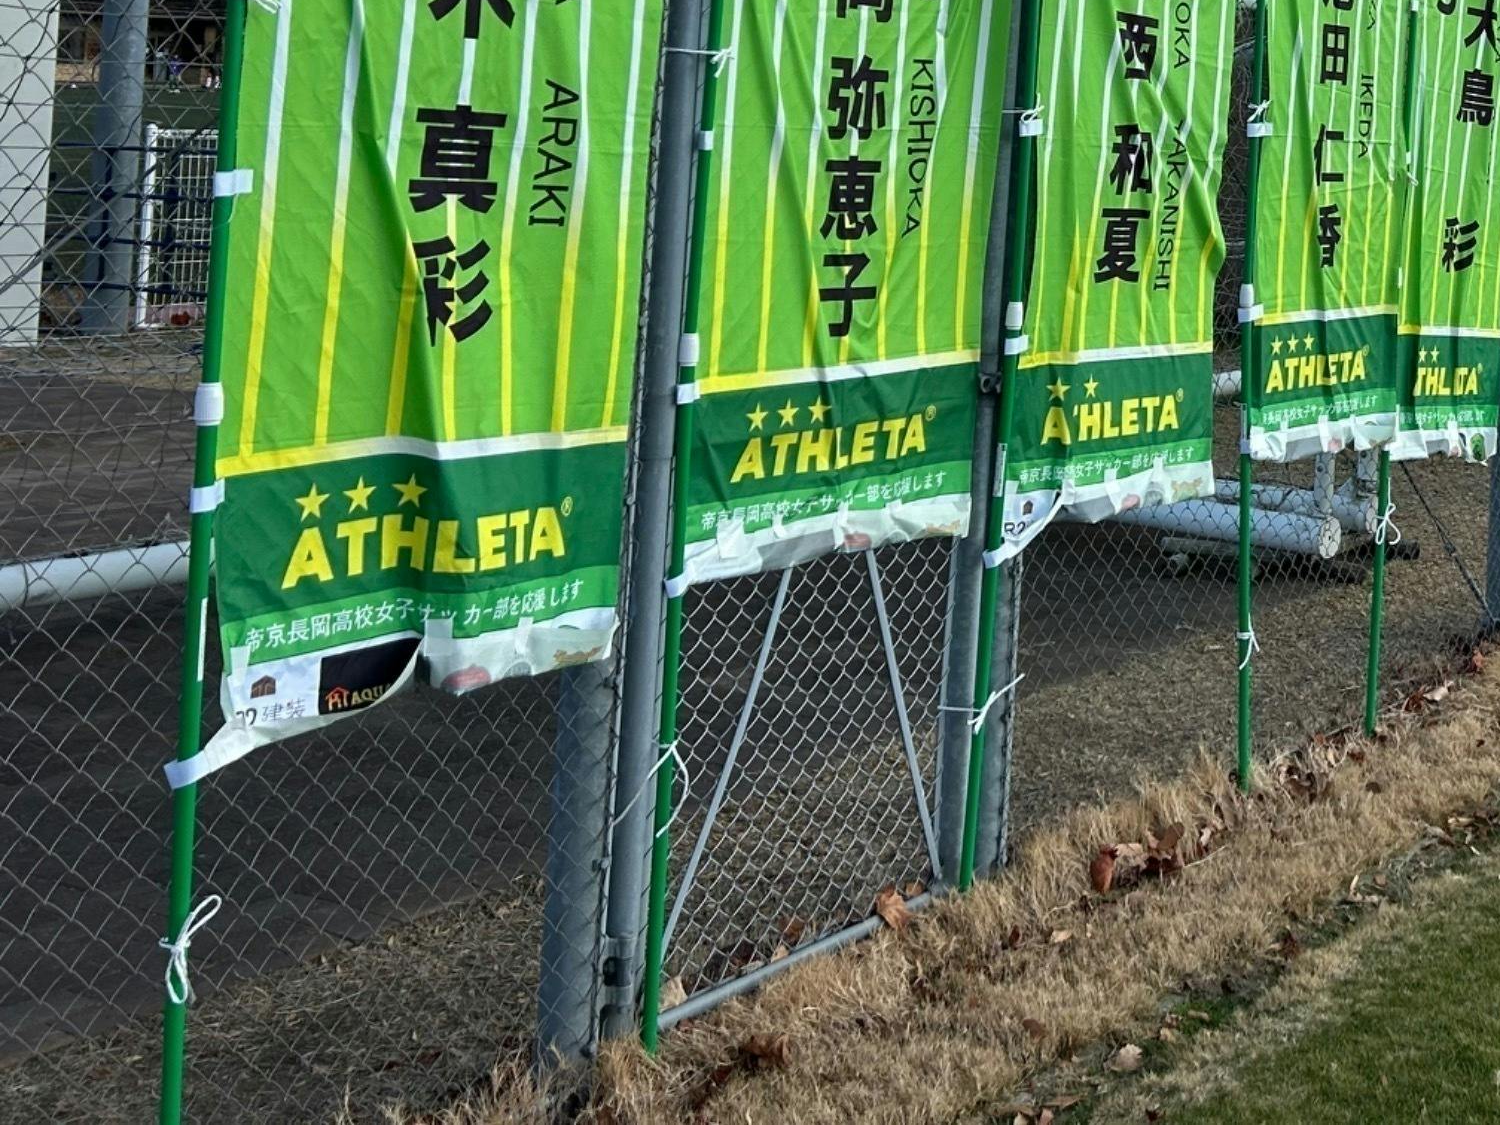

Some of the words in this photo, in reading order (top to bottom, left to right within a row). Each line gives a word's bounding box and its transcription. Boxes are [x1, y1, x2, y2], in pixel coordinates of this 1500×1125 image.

[528, 78, 581, 228] ARAKI
[900, 59, 936, 237] KISHIOKA
[1358, 74, 1374, 158] IKEDA
[1153, 120, 1187, 291] AKANISHI
[730, 416, 926, 483] ATHLETA
[1041, 394, 1178, 445] AHLETA
[281, 507, 566, 590] ATHLETA
